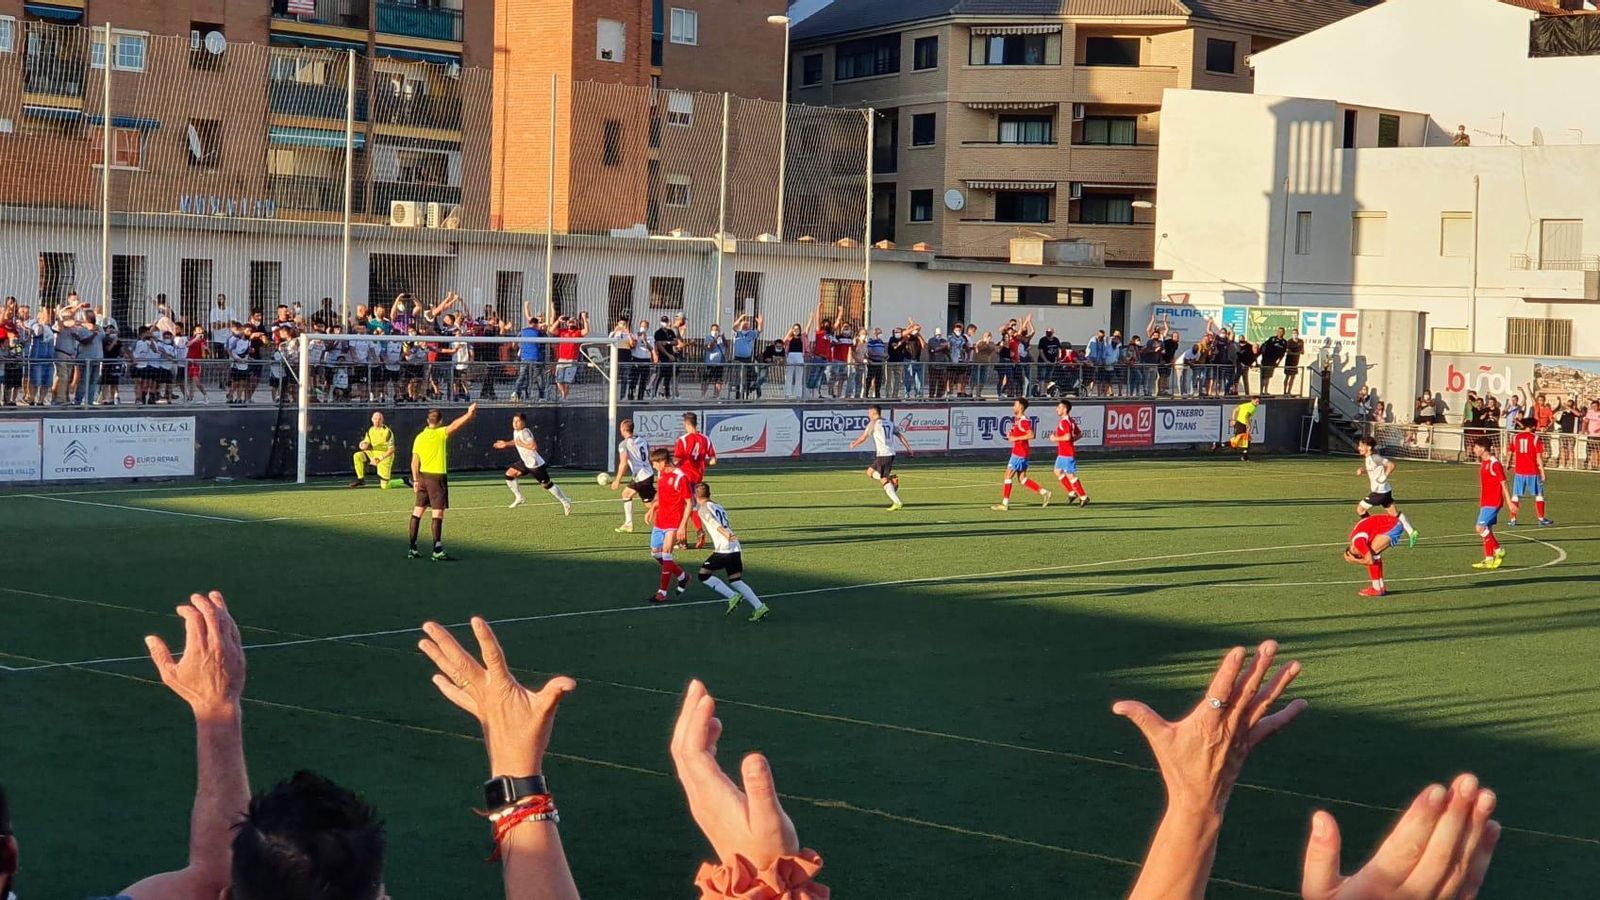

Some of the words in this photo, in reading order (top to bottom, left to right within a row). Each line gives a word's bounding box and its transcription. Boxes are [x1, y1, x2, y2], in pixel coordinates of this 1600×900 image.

[1302, 312, 1357, 337] FFC
[1447, 364, 1512, 394] buñol
[49, 424, 100, 434] TALLERES
[638, 414, 671, 432] RSC
[639, 446, 647, 462] 6
[691, 442, 700, 460] 4
[1519, 438, 1528, 453] 11
